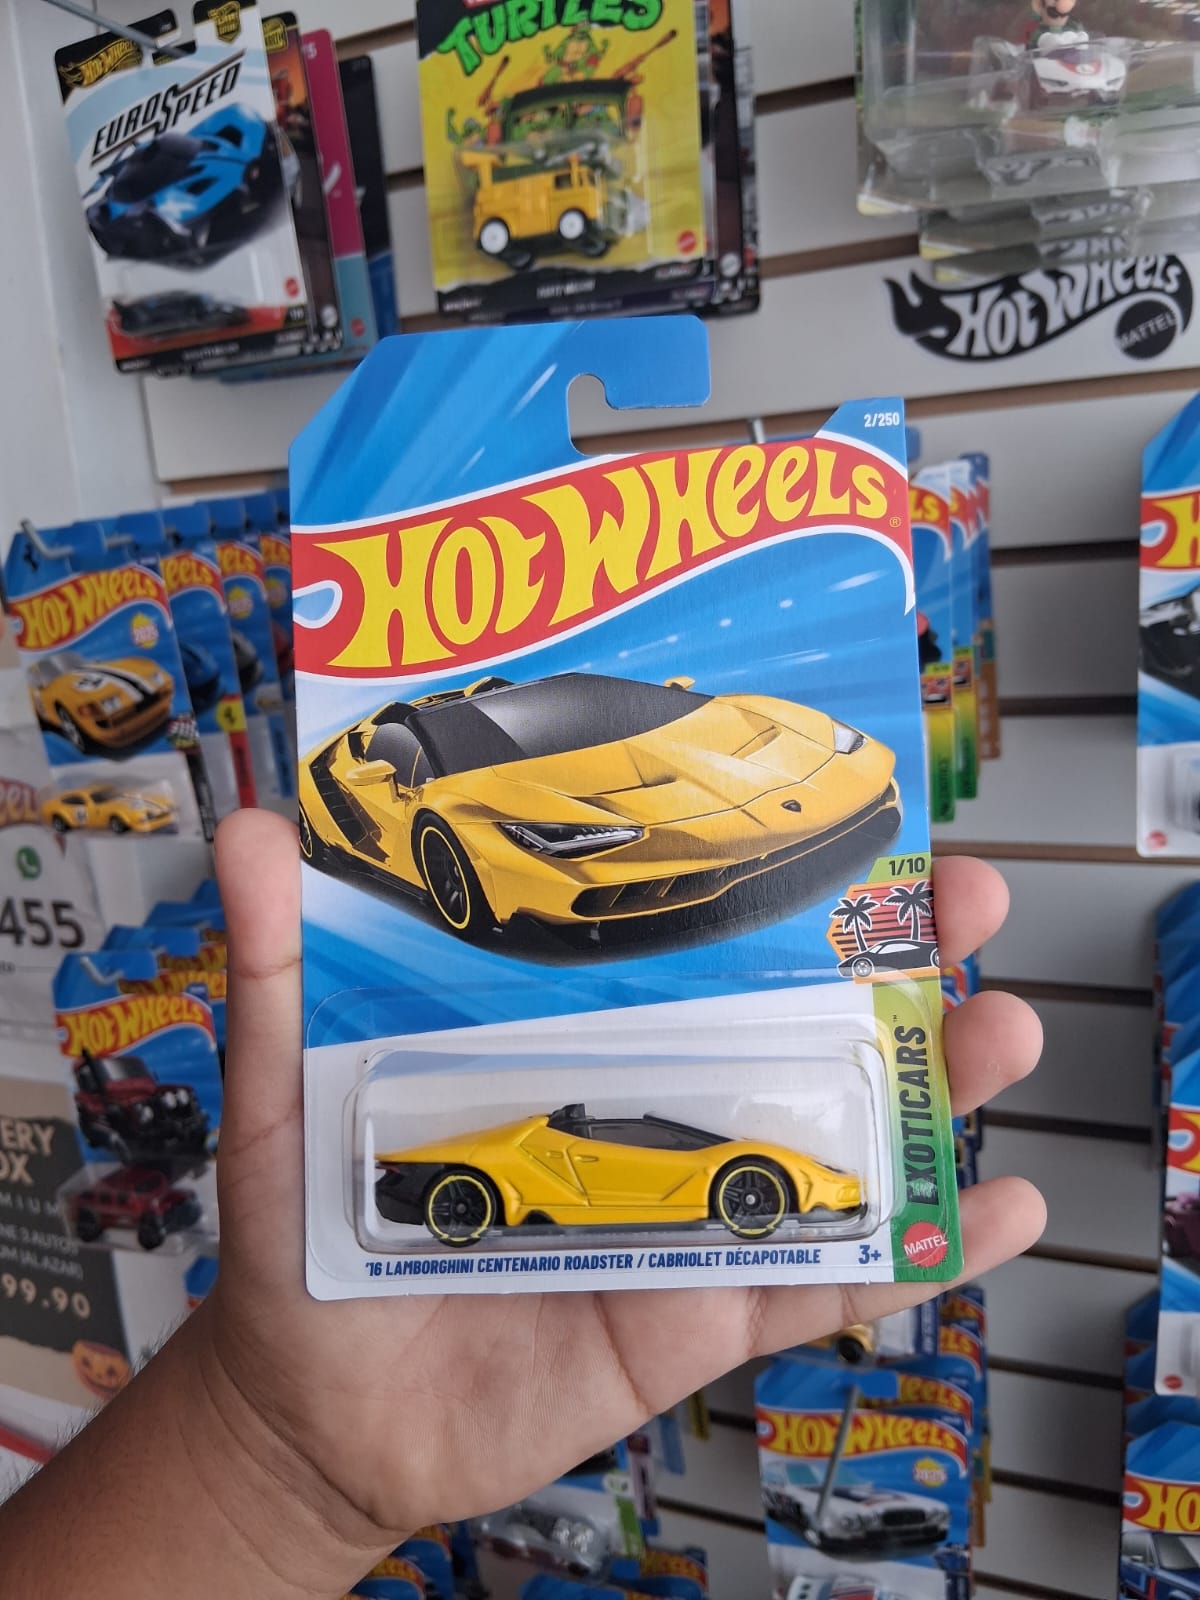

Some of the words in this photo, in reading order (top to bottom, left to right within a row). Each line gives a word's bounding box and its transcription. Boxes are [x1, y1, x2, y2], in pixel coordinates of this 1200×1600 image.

[437, 0, 662, 76] TURTLES
[93, 62, 242, 157] EUROSPEED
[939, 284, 1040, 357] HOT
[1018, 238, 1182, 335] WHEELS
[1117, 311, 1178, 350] MATTEL
[864, 410, 901, 429] 2/250
[314, 516, 547, 668] HOT
[521, 444, 888, 627] WHEELS
[15, 594, 71, 648] HOT
[62, 570, 158, 634] WHEELS
[888, 856, 926, 877] 1/10
[64, 1012, 114, 1057] HOT
[108, 995, 204, 1048] WHEELS
[895, 1025, 940, 1206] EXOTICARS
[385, 1258, 474, 1276] LAMBORGHINI
[477, 1255, 561, 1273] CENTENARIO
[564, 1253, 634, 1271] ROADSTER
[648, 1250, 721, 1269] CABRIOLET
[726, 1247, 821, 1267] DÉCAPOTABLE
[858, 1244, 882, 1265] 3+
[904, 1233, 949, 1256] MATTEL
